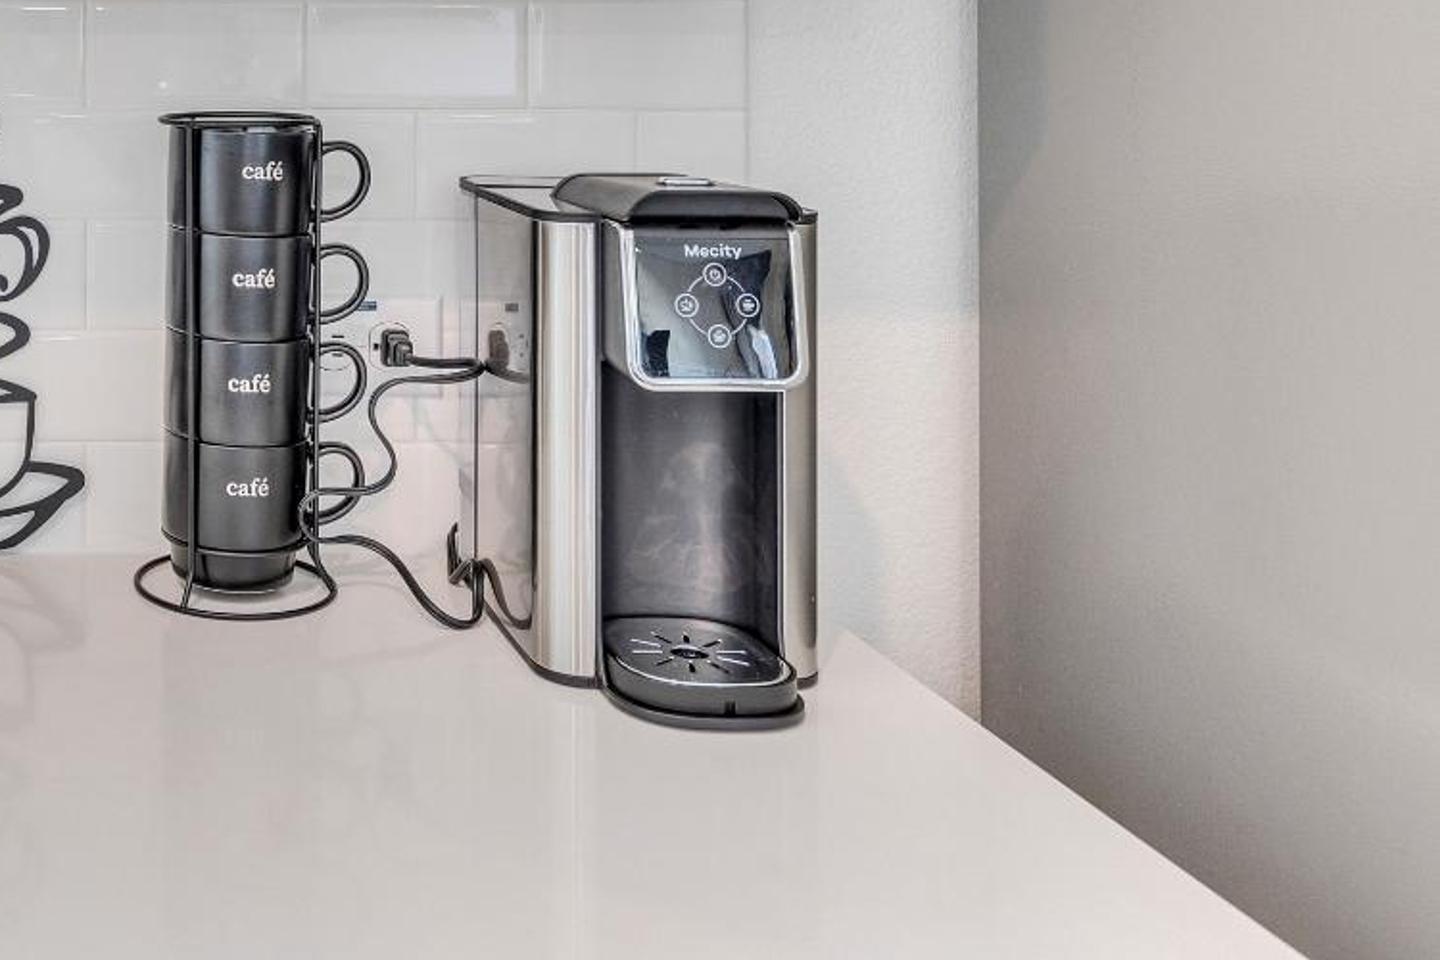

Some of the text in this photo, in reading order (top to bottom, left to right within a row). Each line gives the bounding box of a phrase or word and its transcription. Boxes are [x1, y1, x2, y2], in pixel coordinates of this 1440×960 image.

[242, 161, 283, 181] café
[684, 243, 742, 260] Mecity
[232, 268, 275, 288] café
[228, 373, 271, 393] café
[226, 477, 269, 497] café
